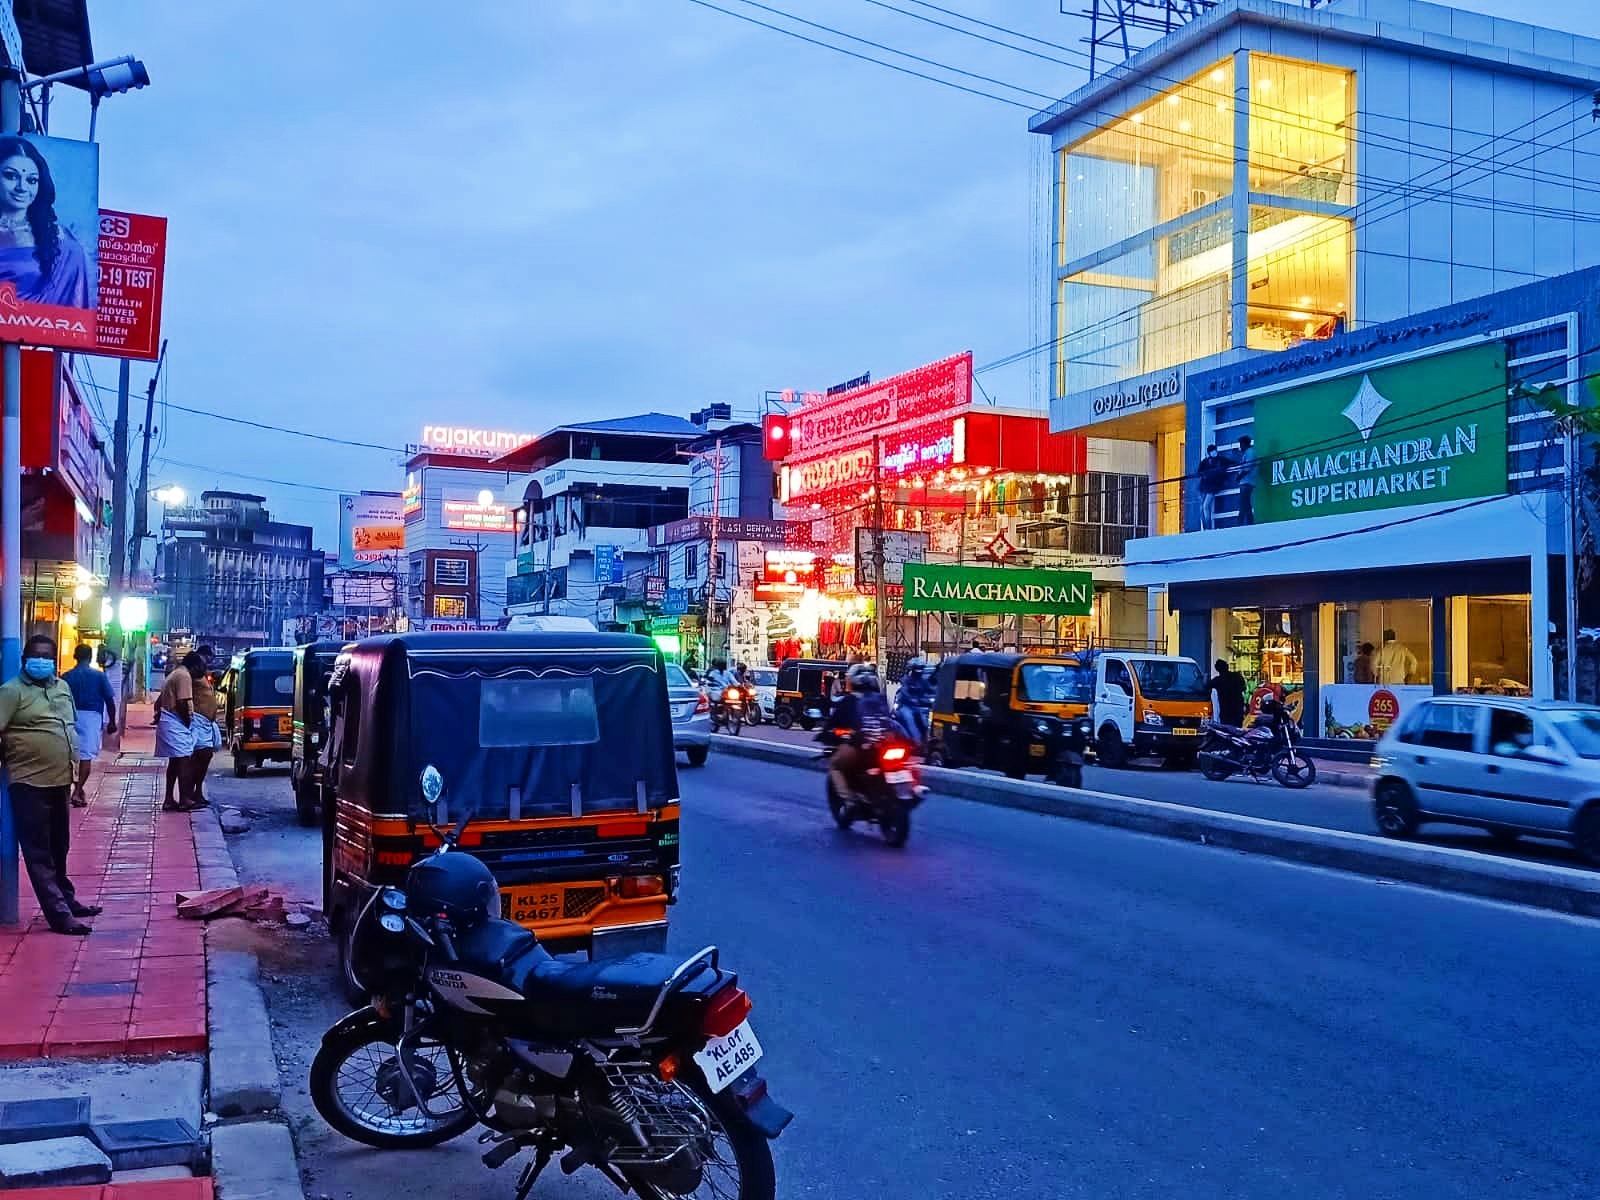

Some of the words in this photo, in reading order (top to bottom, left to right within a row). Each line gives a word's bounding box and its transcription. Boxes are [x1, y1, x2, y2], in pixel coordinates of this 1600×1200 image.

[125, 269, 152, 288] TEST
[105, 298, 143, 309] HEALTH
[114, 315, 138, 325] TEST
[1270, 423, 1479, 486] RAMACHANDRAN
[1291, 466, 1450, 508] SUPERMARKET
[911, 577, 1087, 604] RAMACHANDRAN
[1373, 698, 1393, 713] 365
[514, 907, 560, 921] 6467
[715, 1043, 755, 1081] AE.485
